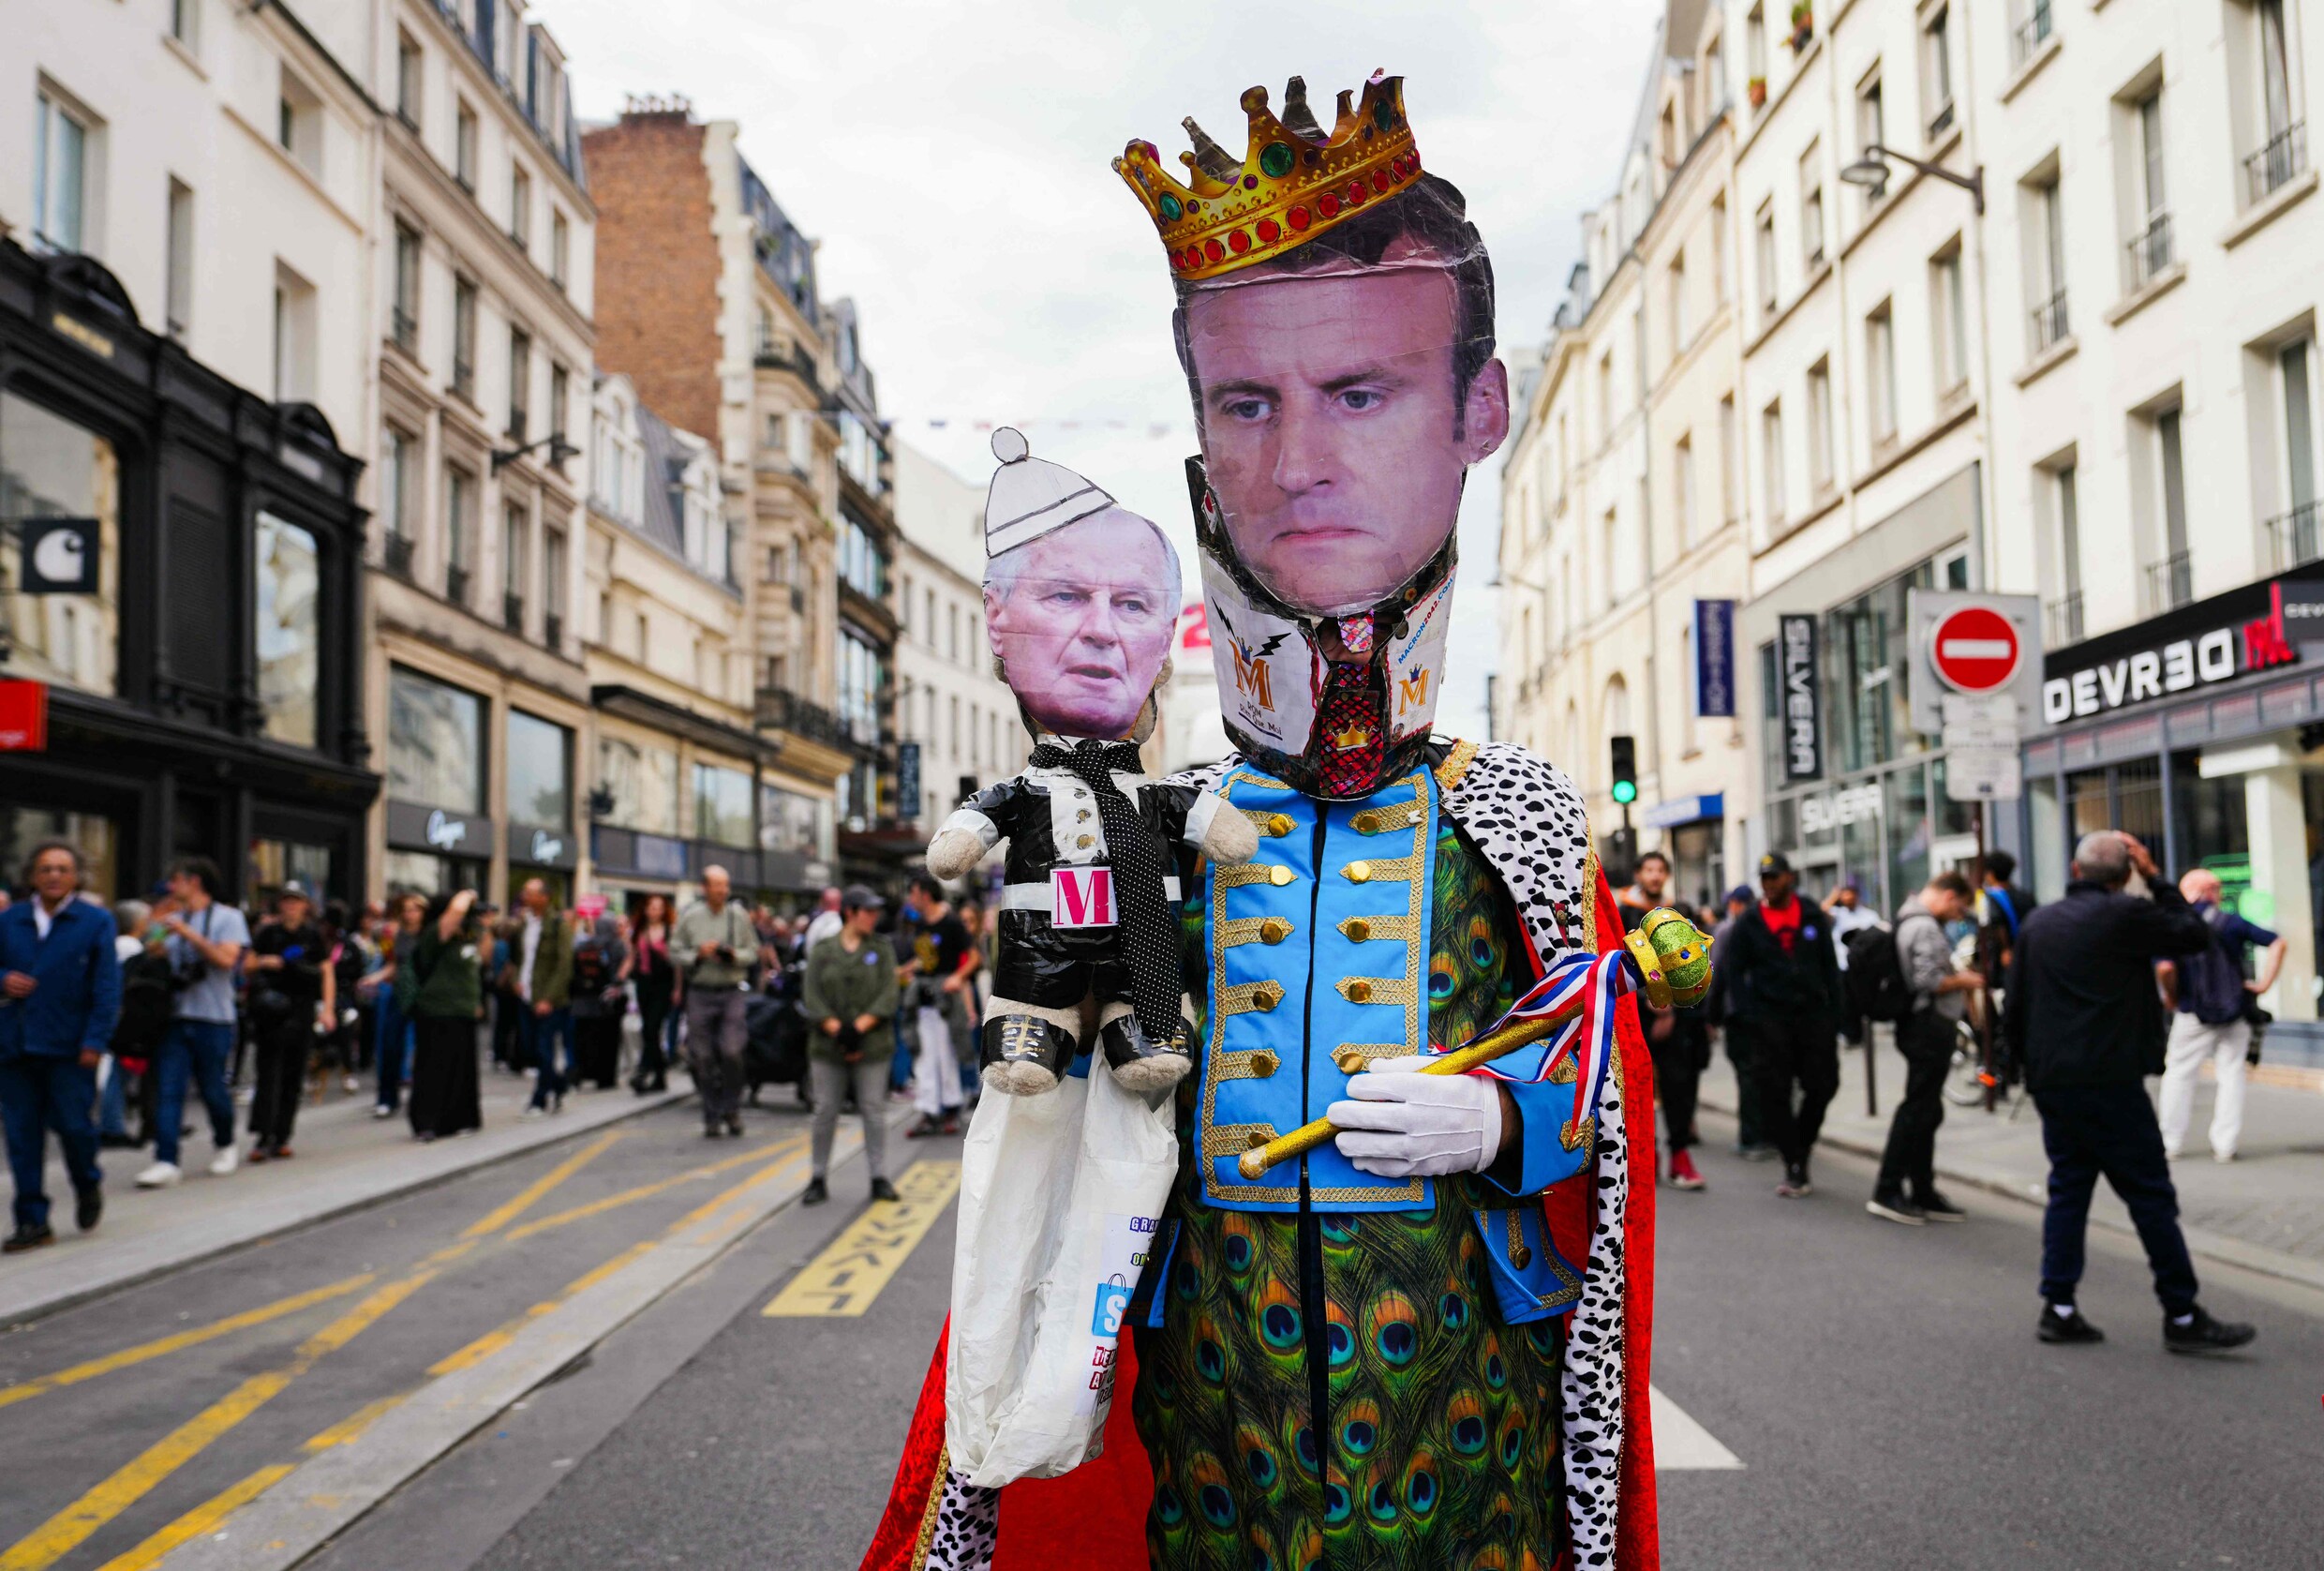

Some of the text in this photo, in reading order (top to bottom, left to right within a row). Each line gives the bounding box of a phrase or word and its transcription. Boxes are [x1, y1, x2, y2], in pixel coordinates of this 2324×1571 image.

[1228, 637, 1275, 712] M
[1397, 668, 1431, 717] M
[1783, 619, 1815, 774] SILVERA
[1267, 722, 1282, 736] Moi
[1053, 870, 1114, 925] M
[1105, 1294, 1126, 1333] S
